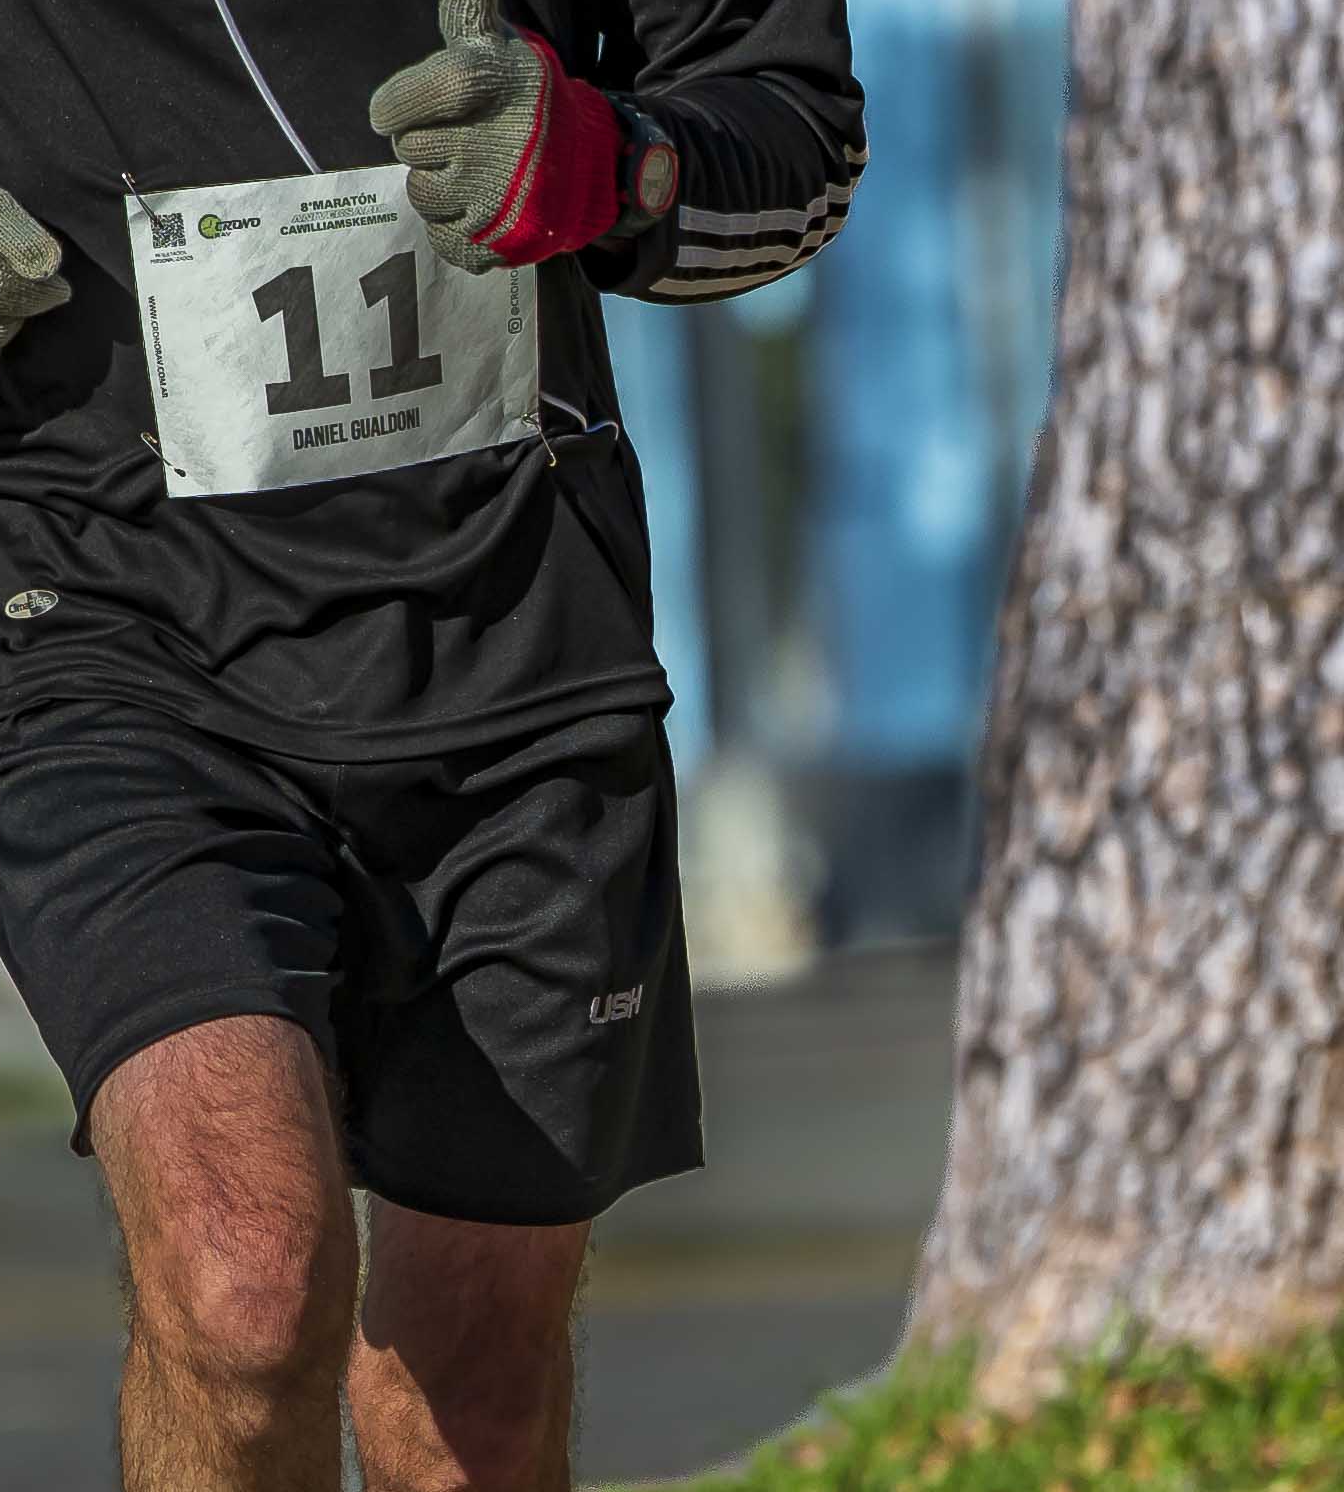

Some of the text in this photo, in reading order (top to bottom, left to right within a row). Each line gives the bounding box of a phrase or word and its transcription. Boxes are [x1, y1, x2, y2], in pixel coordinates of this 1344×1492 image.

[251, 250, 443, 416] 11
[292, 407, 421, 451] DANIEL GUALDONI
